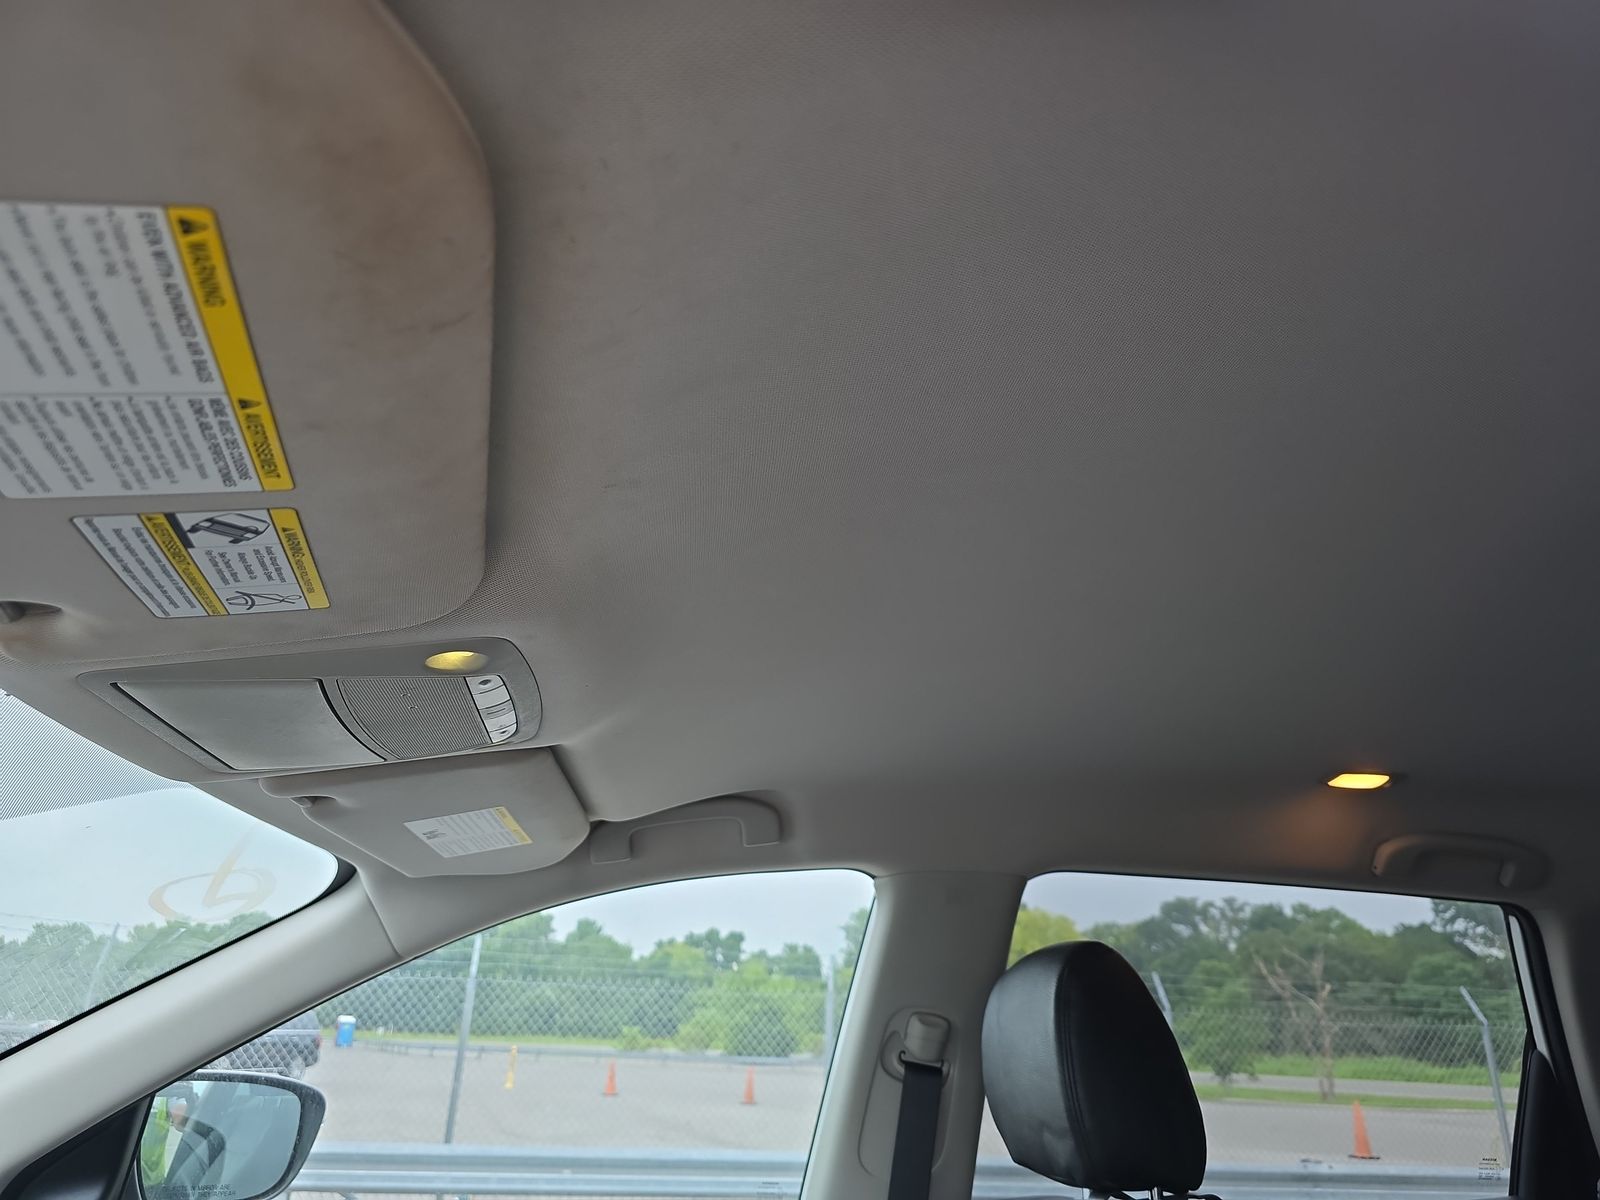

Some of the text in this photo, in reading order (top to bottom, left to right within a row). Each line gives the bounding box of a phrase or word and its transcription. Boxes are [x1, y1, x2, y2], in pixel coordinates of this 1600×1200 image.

[150, 250, 174, 279] WITH
[187, 241, 226, 308] WARNING
[163, 282, 198, 338] ADVANCED
[186, 342, 205, 356] AIR
[192, 359, 214, 383] BAGS
[243, 414, 281, 479] AVERTISSEMENT
